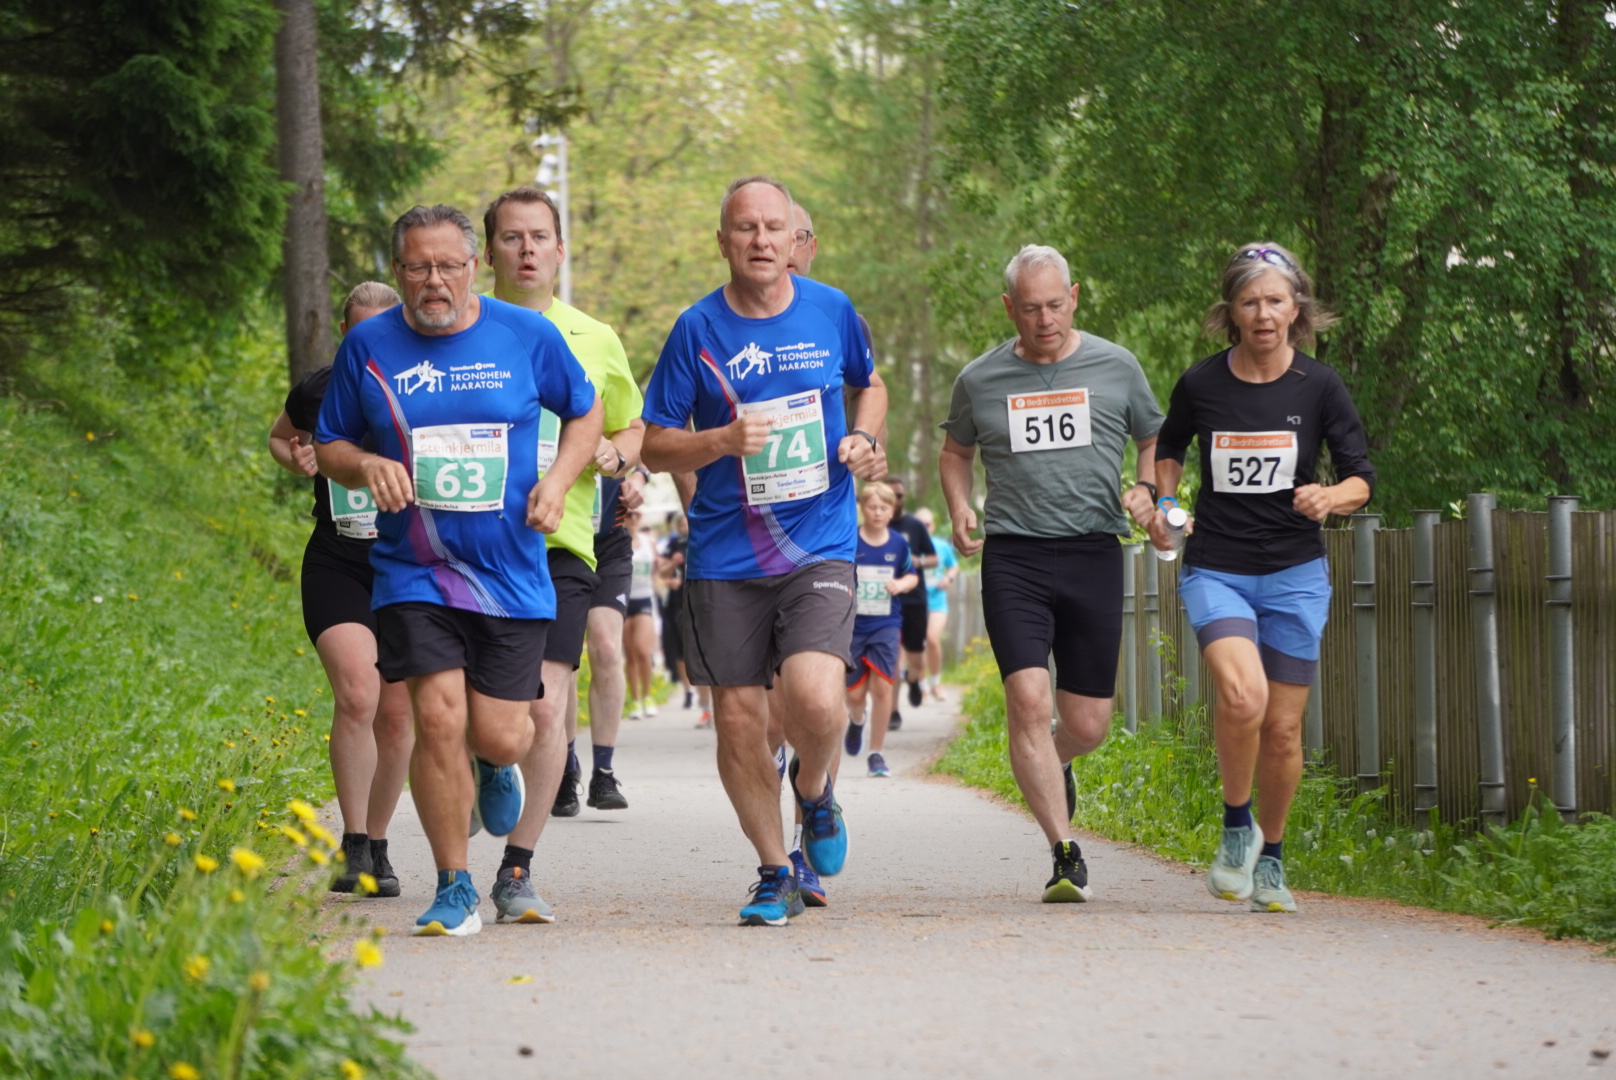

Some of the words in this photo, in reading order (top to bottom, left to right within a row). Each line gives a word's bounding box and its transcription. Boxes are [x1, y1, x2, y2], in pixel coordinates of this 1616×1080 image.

[777, 349, 830, 362] TRONDHEIM
[779, 360, 823, 372] MARATON
[450, 371, 511, 382] TRONDHEIM
[450, 380, 503, 391] MARATON
[1027, 395, 1081, 406] Bedriftsidretten
[1025, 412, 1075, 444] 516
[766, 428, 811, 469] 74
[435, 461, 487, 499] 63
[1228, 456, 1281, 487] 527
[347, 489, 378, 510] 6
